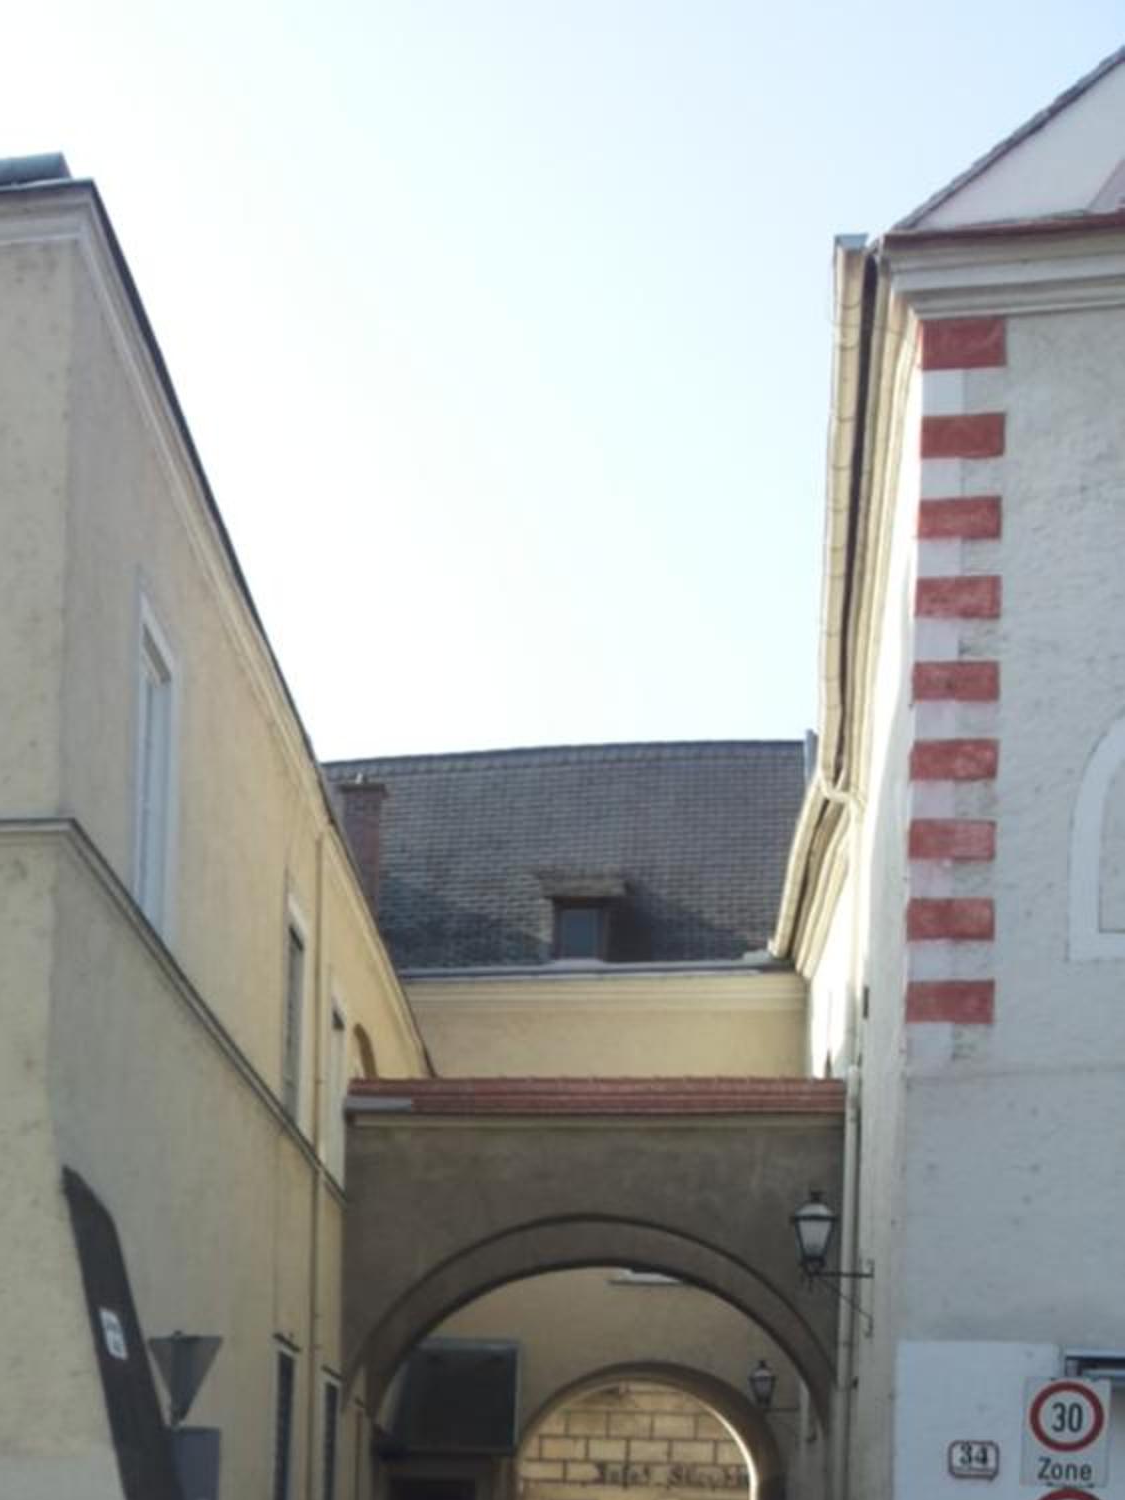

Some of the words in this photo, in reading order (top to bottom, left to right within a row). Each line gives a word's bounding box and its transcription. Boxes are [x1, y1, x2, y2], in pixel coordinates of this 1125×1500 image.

[1051, 1401, 1083, 1433] 30
[959, 1441, 988, 1465] 34
[1037, 1456, 1092, 1481] Zone
